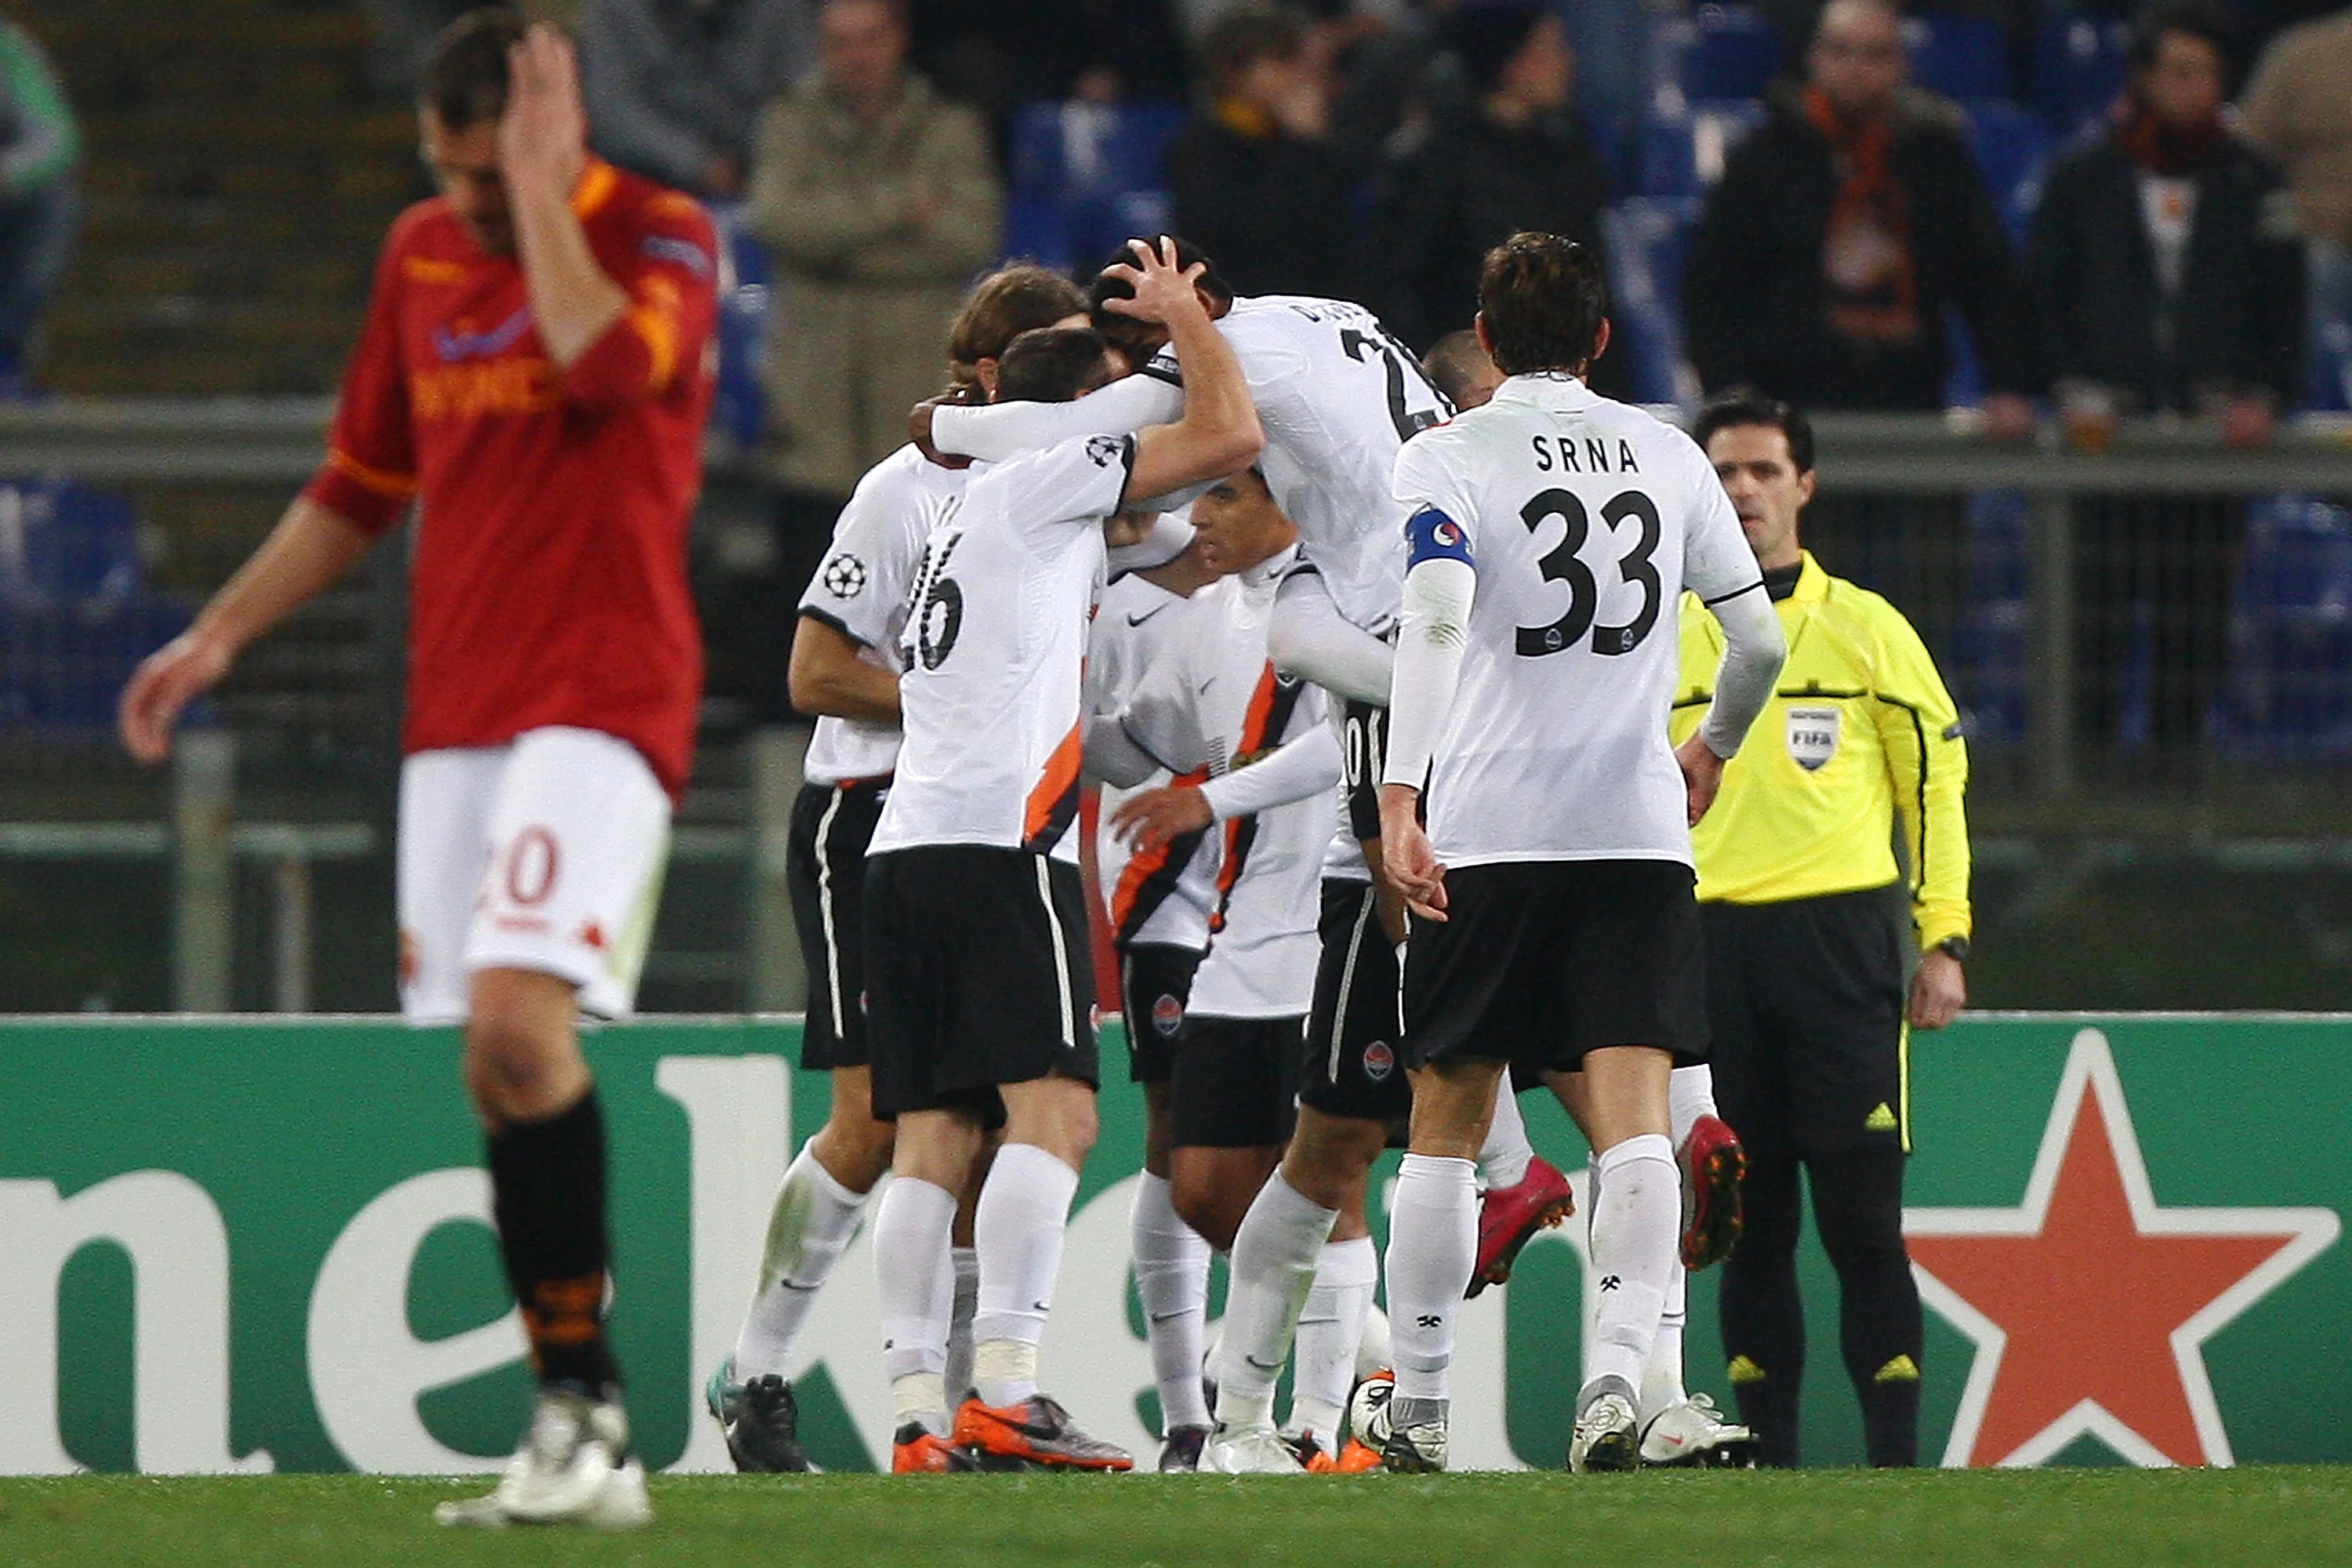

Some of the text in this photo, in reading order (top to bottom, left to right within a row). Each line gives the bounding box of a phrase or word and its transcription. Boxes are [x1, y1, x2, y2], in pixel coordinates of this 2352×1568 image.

[1533, 435, 1639, 474] SRNA
[1515, 488, 1661, 657] 33
[1793, 731, 1832, 746] FIFA
